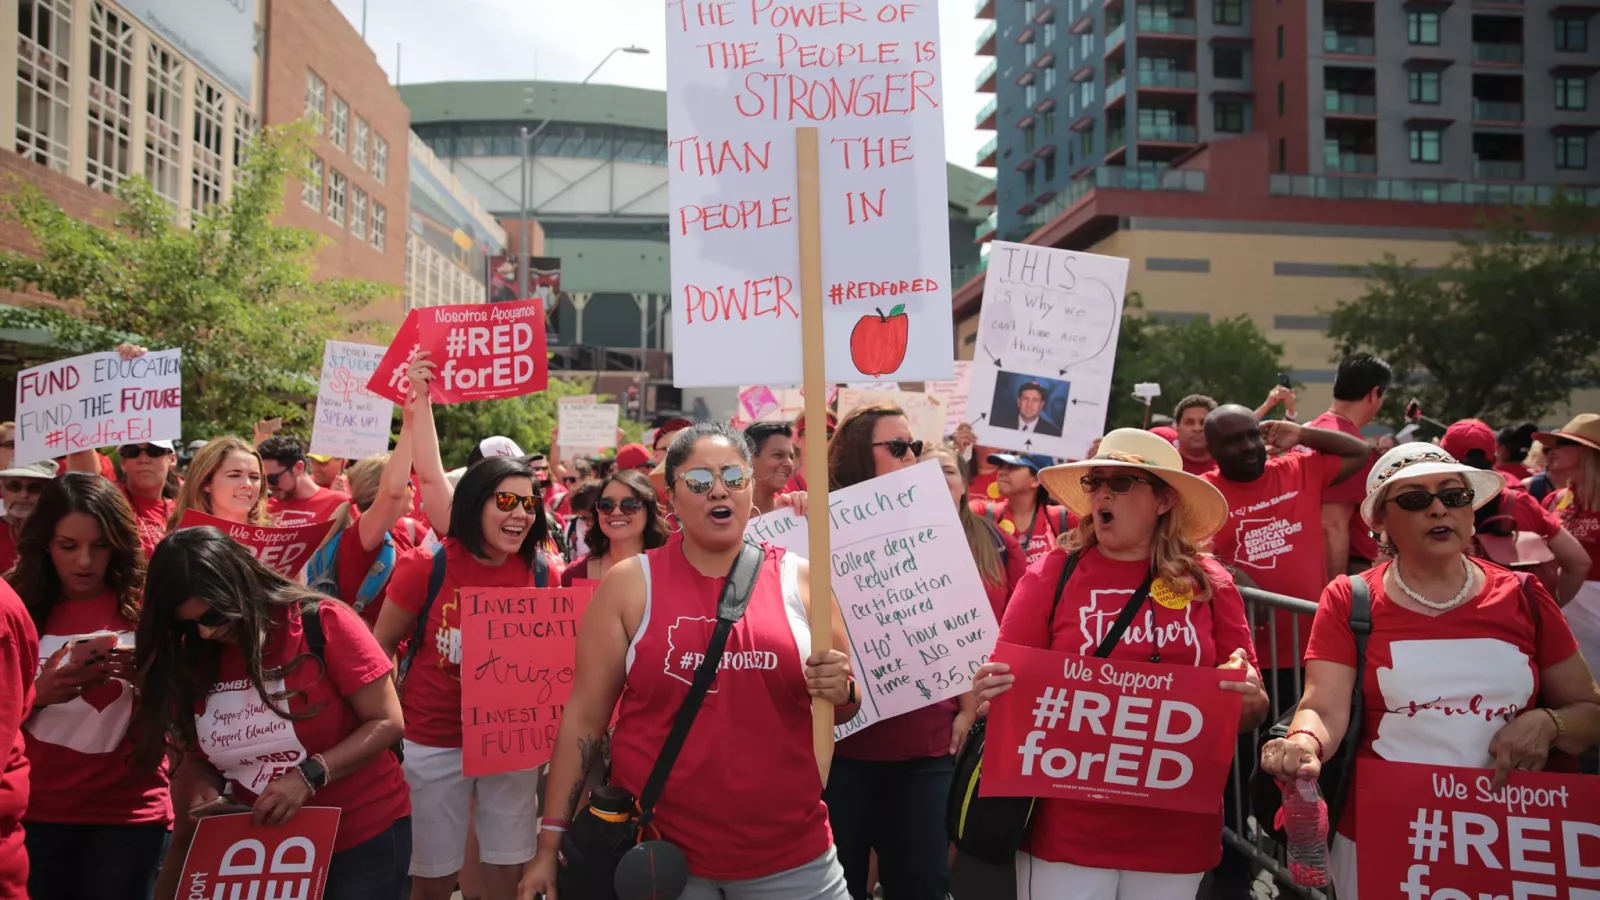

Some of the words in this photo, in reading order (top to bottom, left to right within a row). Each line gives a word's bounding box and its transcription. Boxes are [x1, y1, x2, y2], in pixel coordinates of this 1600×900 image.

[668, 0, 736, 31] THE
[877, 4, 921, 23] OF
[697, 41, 764, 69] THE
[777, 33, 900, 69] PEOPLE
[914, 41, 937, 63] IS
[734, 70, 940, 122] STRONGER
[669, 136, 772, 176] THAN
[830, 136, 915, 170] THE
[679, 196, 792, 236] PEOPLE
[846, 188, 886, 225] IN
[1001, 247, 1077, 290] THIS
[435, 308, 488, 324] Nosotros
[490, 305, 536, 324] Apoyamos
[684, 275, 799, 325] POWER
[828, 278, 939, 306] #REDFORED
[1064, 306, 1087, 318] we
[446, 322, 534, 358] #RED
[328, 354, 381, 372] STUDEN
[441, 354, 535, 391] forED
[20, 364, 81, 404] FUND
[20, 403, 73, 441] FUND
[79, 393, 113, 420] THE
[120, 386, 182, 413] FUTURE
[320, 408, 358, 428] SPEAK
[360, 415, 379, 428] UP!
[44, 417, 153, 452] #RedforEd
[828, 485, 920, 531] Teacher
[228, 524, 250, 540] We
[251, 528, 299, 546] Support
[1243, 518, 1291, 541] ARIZONA
[1243, 522, 1303, 548] EDUCATORS
[1245, 538, 1286, 556] UNITED
[832, 549, 877, 578] College
[884, 527, 938, 558] degree
[853, 555, 919, 592] Required
[465, 592, 538, 617] INVEST
[551, 596, 574, 614] IN
[875, 597, 934, 627] Required
[487, 619, 579, 641] EDUCATI
[902, 622, 939, 648] hour
[474, 649, 576, 705] Arizo
[1064, 658, 1093, 682] We
[1098, 664, 1173, 694] Support
[468, 706, 539, 727] INVEST
[1032, 686, 1204, 744] #RED
[210, 729, 242, 748] Support
[481, 725, 557, 757] FUTUR
[1018, 730, 1194, 790] forED
[1432, 772, 1468, 800] We
[1475, 775, 1569, 814] Support
[1408, 807, 1600, 880] #RED
